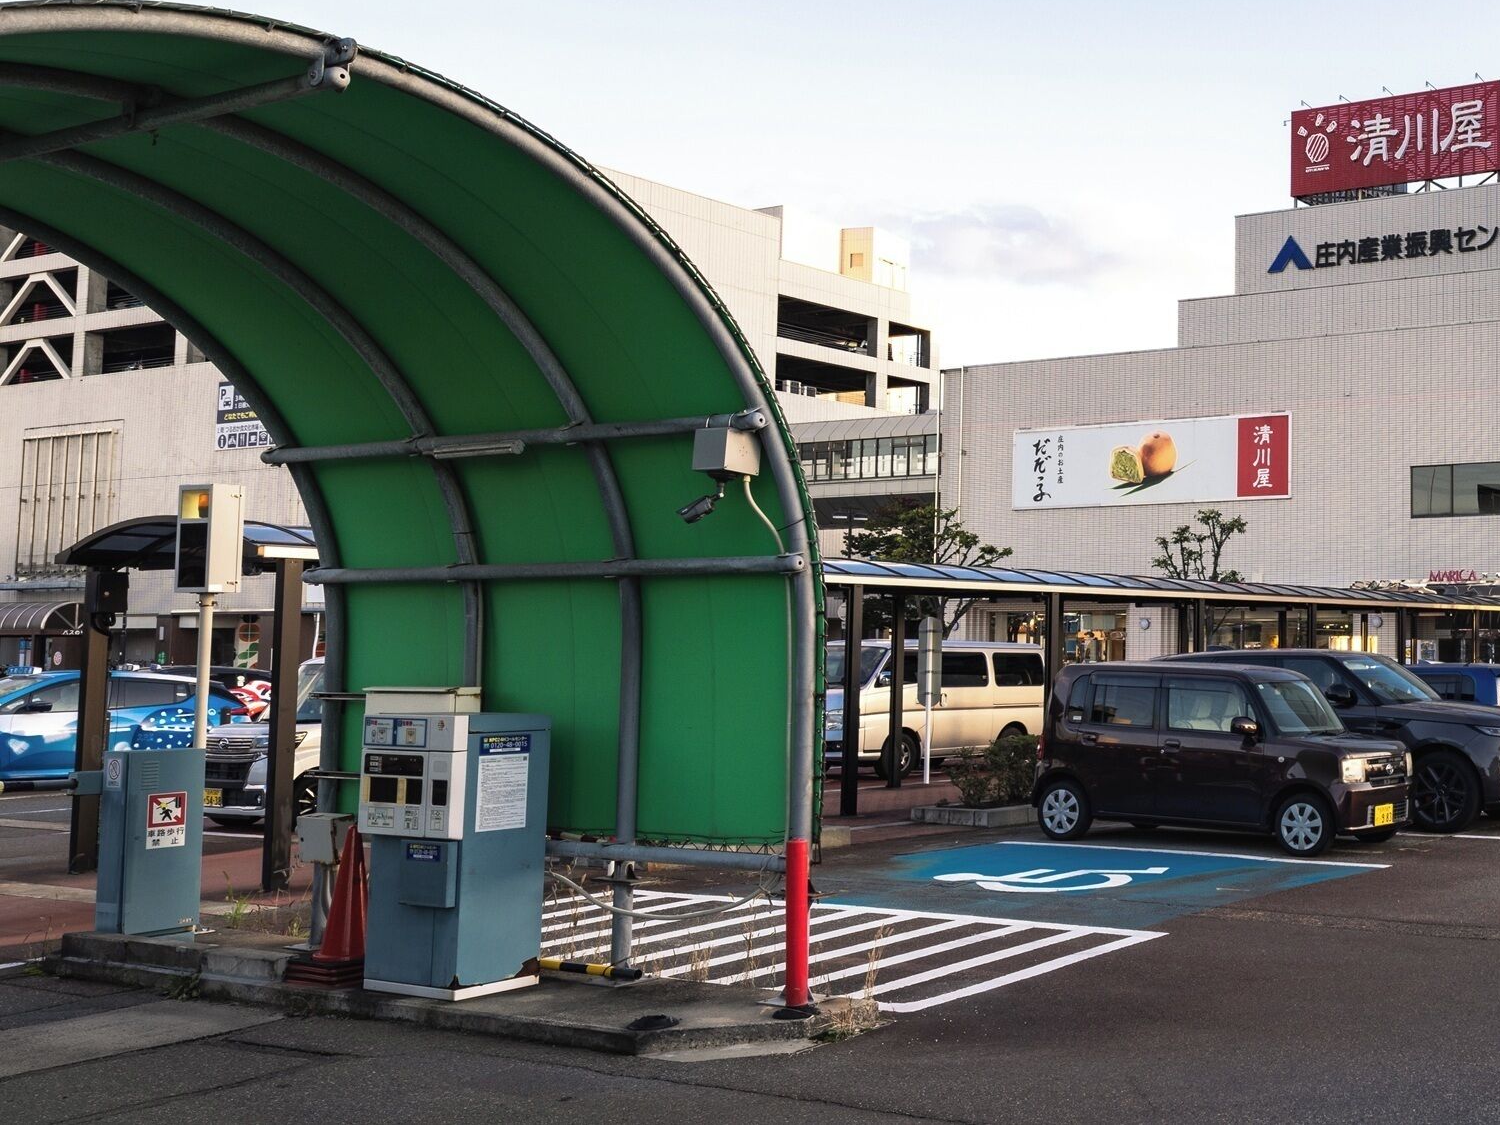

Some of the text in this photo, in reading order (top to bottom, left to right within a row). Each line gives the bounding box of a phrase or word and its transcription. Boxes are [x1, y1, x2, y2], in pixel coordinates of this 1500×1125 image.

[1346, 100, 1492, 167] 清川屋
[1057, 434, 1065, 484] 庄内のお土産
[1252, 423, 1274, 489] 清川屋
[1429, 569, 1477, 583] MARICA
[147, 827, 185, 838] 車路歩行
